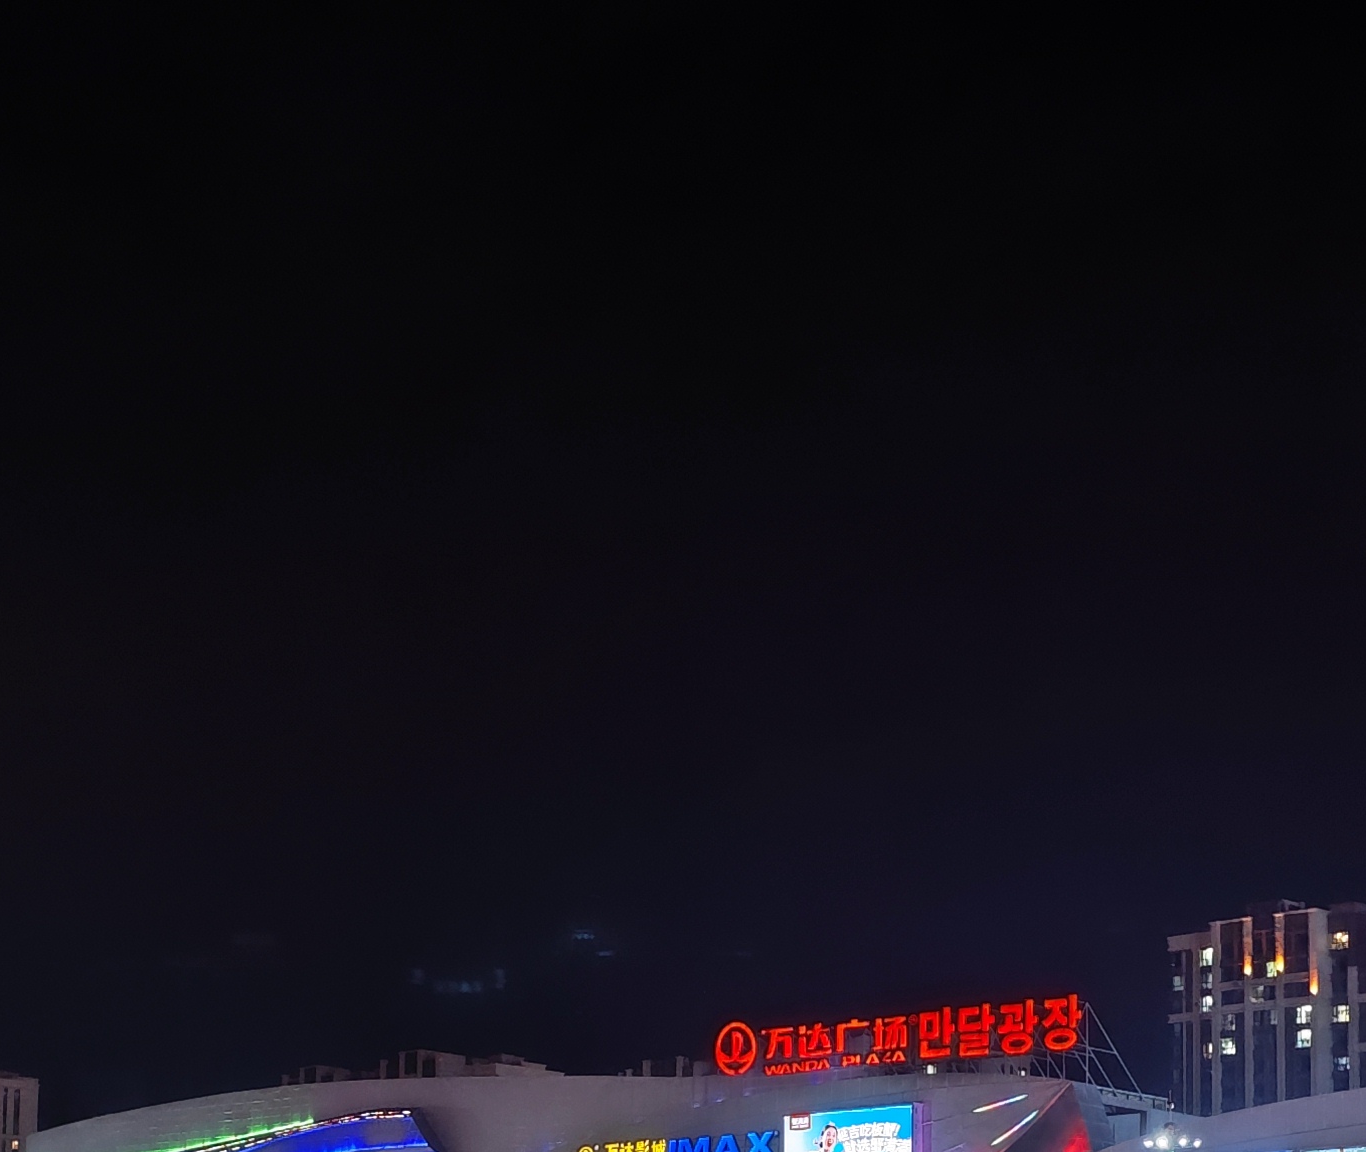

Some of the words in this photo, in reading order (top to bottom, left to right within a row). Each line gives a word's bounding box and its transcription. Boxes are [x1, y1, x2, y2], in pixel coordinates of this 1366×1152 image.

[761, 1015, 909, 1058] 万达广场
[919, 993, 1082, 1059] 만달광장
[764, 1058, 831, 1076] WANDA
